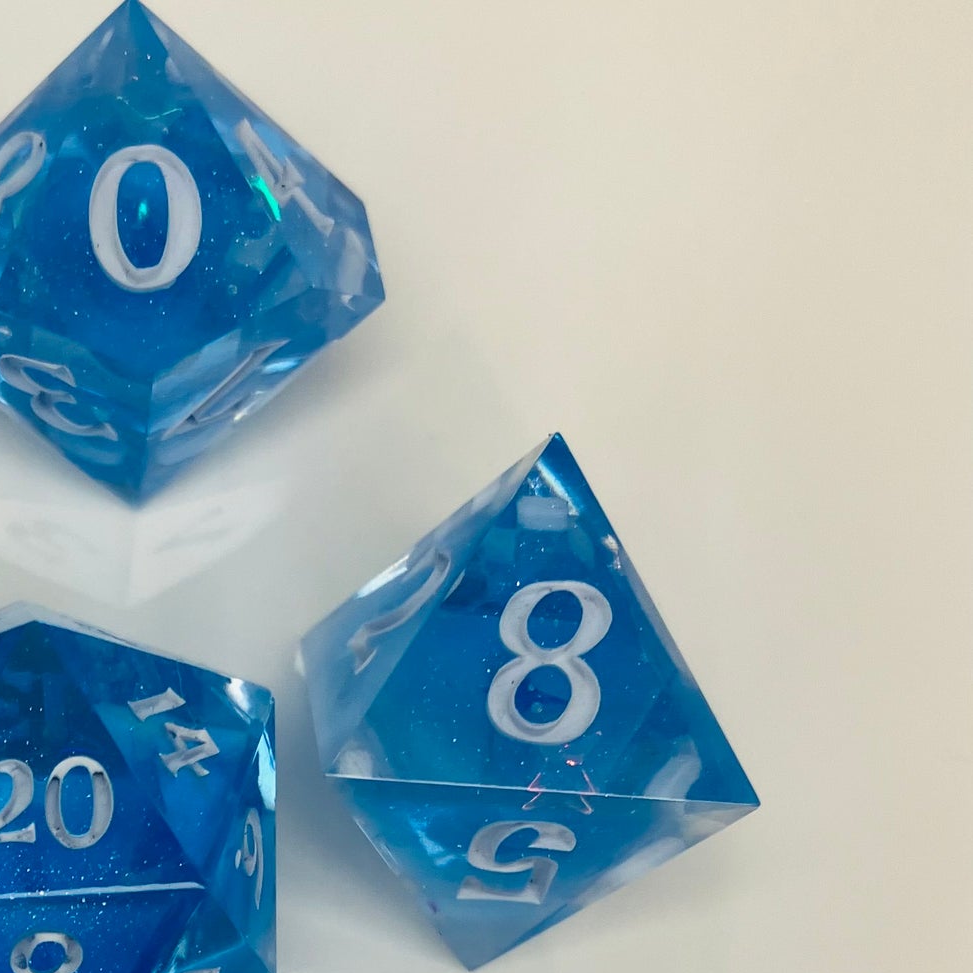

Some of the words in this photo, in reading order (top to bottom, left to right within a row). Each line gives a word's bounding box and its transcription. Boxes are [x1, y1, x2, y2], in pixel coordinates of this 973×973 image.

[89, 144, 202, 293] 0
[234, 117, 334, 237] 4
[487, 580, 613, 745] 8
[127, 687, 221, 778] 14
[456, 820, 577, 905] 5
